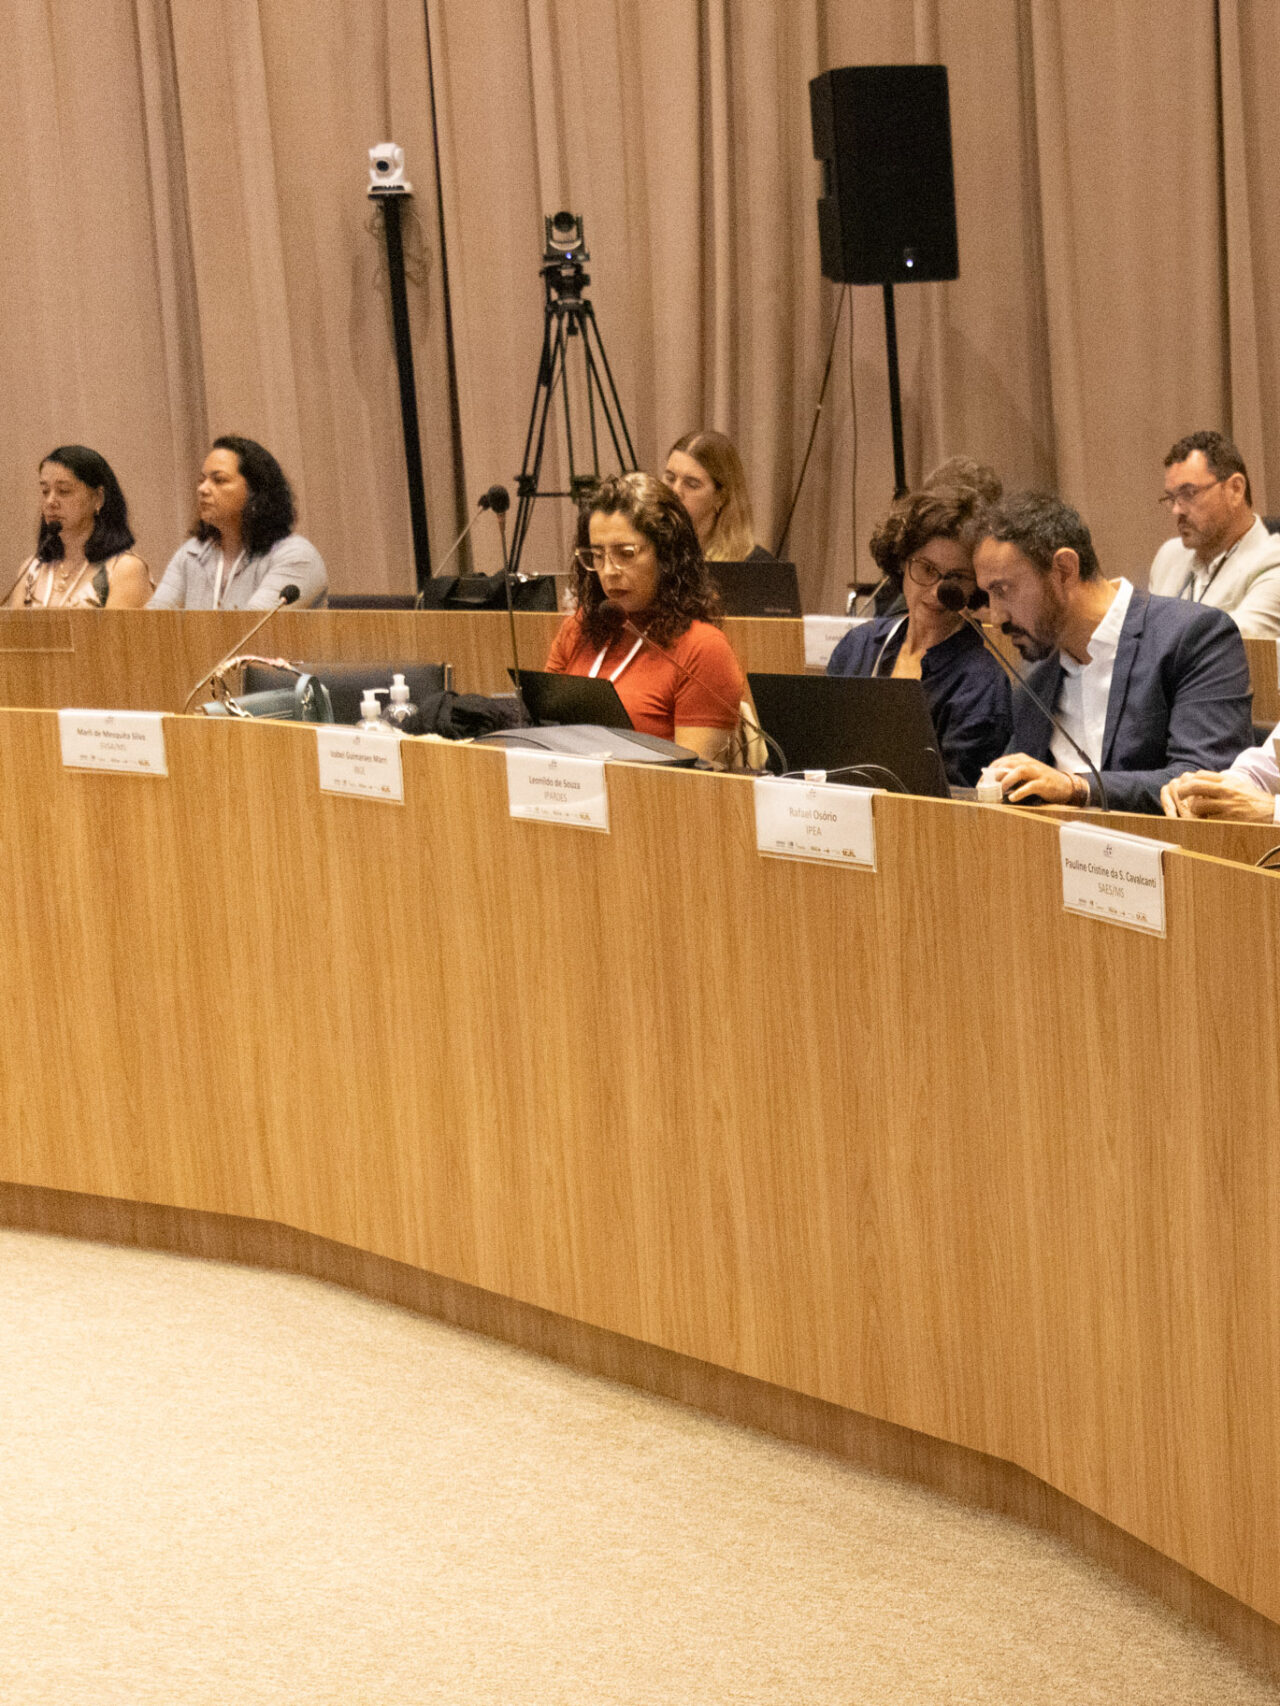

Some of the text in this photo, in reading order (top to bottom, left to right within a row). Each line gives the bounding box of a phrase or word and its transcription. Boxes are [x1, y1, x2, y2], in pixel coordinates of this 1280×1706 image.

[563, 779, 581, 789] Souza
[789, 807, 838, 822] Rafael Osório
[806, 825, 823, 837] IPEA
[1065, 858, 1087, 872] Pauline
[1087, 862, 1110, 877] Cristine
[1110, 867, 1119, 879] da
[1125, 871, 1157, 888] Cavalcanti
